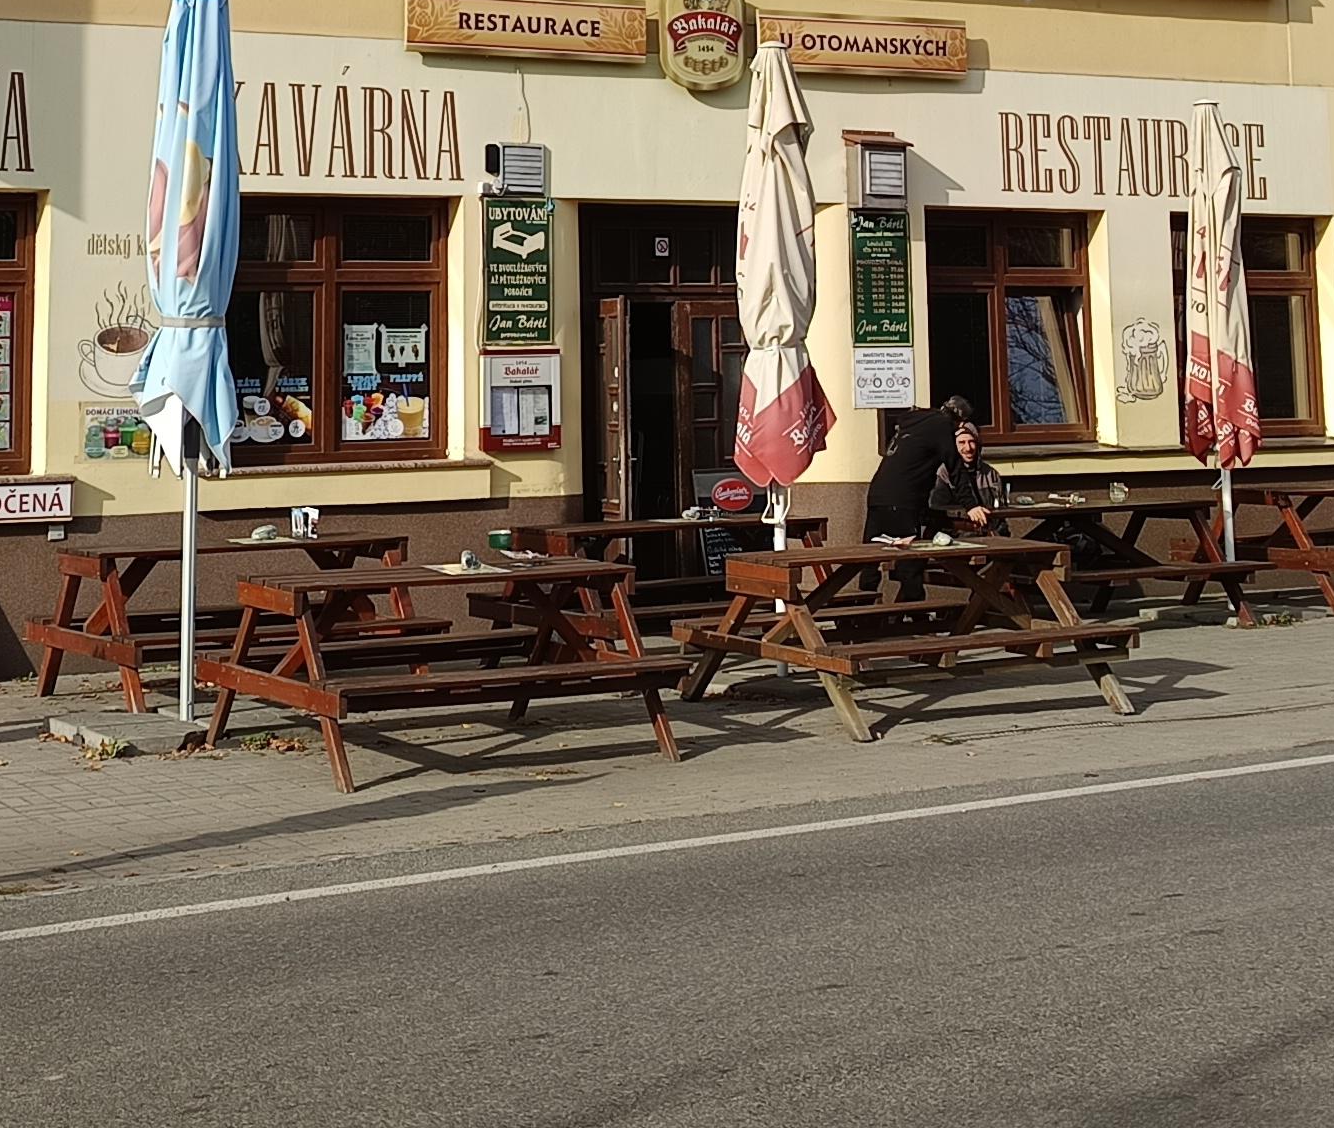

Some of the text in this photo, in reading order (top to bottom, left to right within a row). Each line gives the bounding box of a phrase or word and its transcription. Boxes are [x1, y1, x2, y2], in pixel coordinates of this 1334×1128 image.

[457, 10, 601, 39] RESTAURACE
[672, 13, 737, 35] Bakalář
[801, 30, 948, 58] OTOMANSKÝCH
[998, 111, 1268, 201] RESTAURE
[87, 234, 131, 260] dětský
[489, 315, 547, 332] Jan Bártl
[857, 320, 907, 335] Jan Bártl
[504, 366, 539, 376] Bakalář
[85, 406, 115, 416] DOMÁCÍ
